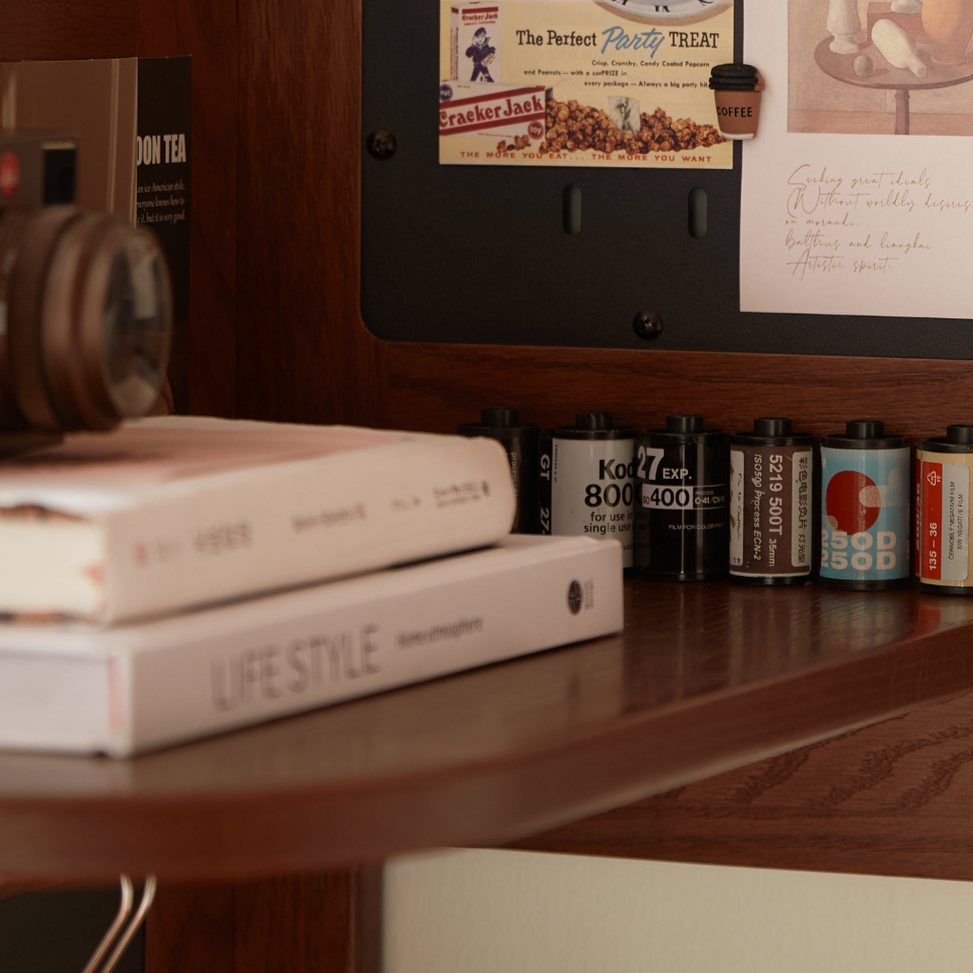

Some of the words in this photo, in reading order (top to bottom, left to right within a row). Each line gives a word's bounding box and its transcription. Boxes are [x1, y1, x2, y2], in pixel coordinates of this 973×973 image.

[516, 30, 543, 46] The
[546, 30, 597, 46] Perfect
[601, 26, 666, 58] Party
[669, 31, 719, 48] TREAT
[439, 104, 502, 127] Cracker
[503, 94, 544, 116] Jack
[716, 106, 753, 118] COFFEE
[163, 133, 186, 163] TEA
[787, 164, 844, 192] Seeking
[850, 171, 894, 189] great
[890, 168, 931, 189] ideals
[137, 200, 154, 211] veryone
[155, 196, 169, 206] knows
[170, 195, 179, 206] how
[179, 196, 185, 205] to
[786, 186, 870, 218] Without
[866, 189, 916, 212] worldly
[848, 234, 872, 249] and
[787, 248, 844, 281] Artistic
[540, 454, 550, 481] GT
[599, 458, 637, 480] Kod
[637, 446, 664, 480] 27
[662, 468, 692, 480] EXP.
[754, 454, 762, 488] ISO500
[769, 454, 783, 492] 5219
[584, 483, 633, 507] 800
[651, 488, 690, 507] 400
[798, 457, 808, 530] 彩色电影负片
[591, 512, 606, 521] for
[754, 490, 762, 528] Process
[769, 497, 782, 535] 500T
[584, 523, 615, 535] single
[618, 524, 631, 532] use
[822, 529, 896, 550] 250D
[930, 522, 937, 537] 36
[768, 538, 777, 567] 35mm
[821, 550, 896, 570] 250D
[929, 551, 937, 571] 135
[286, 622, 381, 693] STYLE
